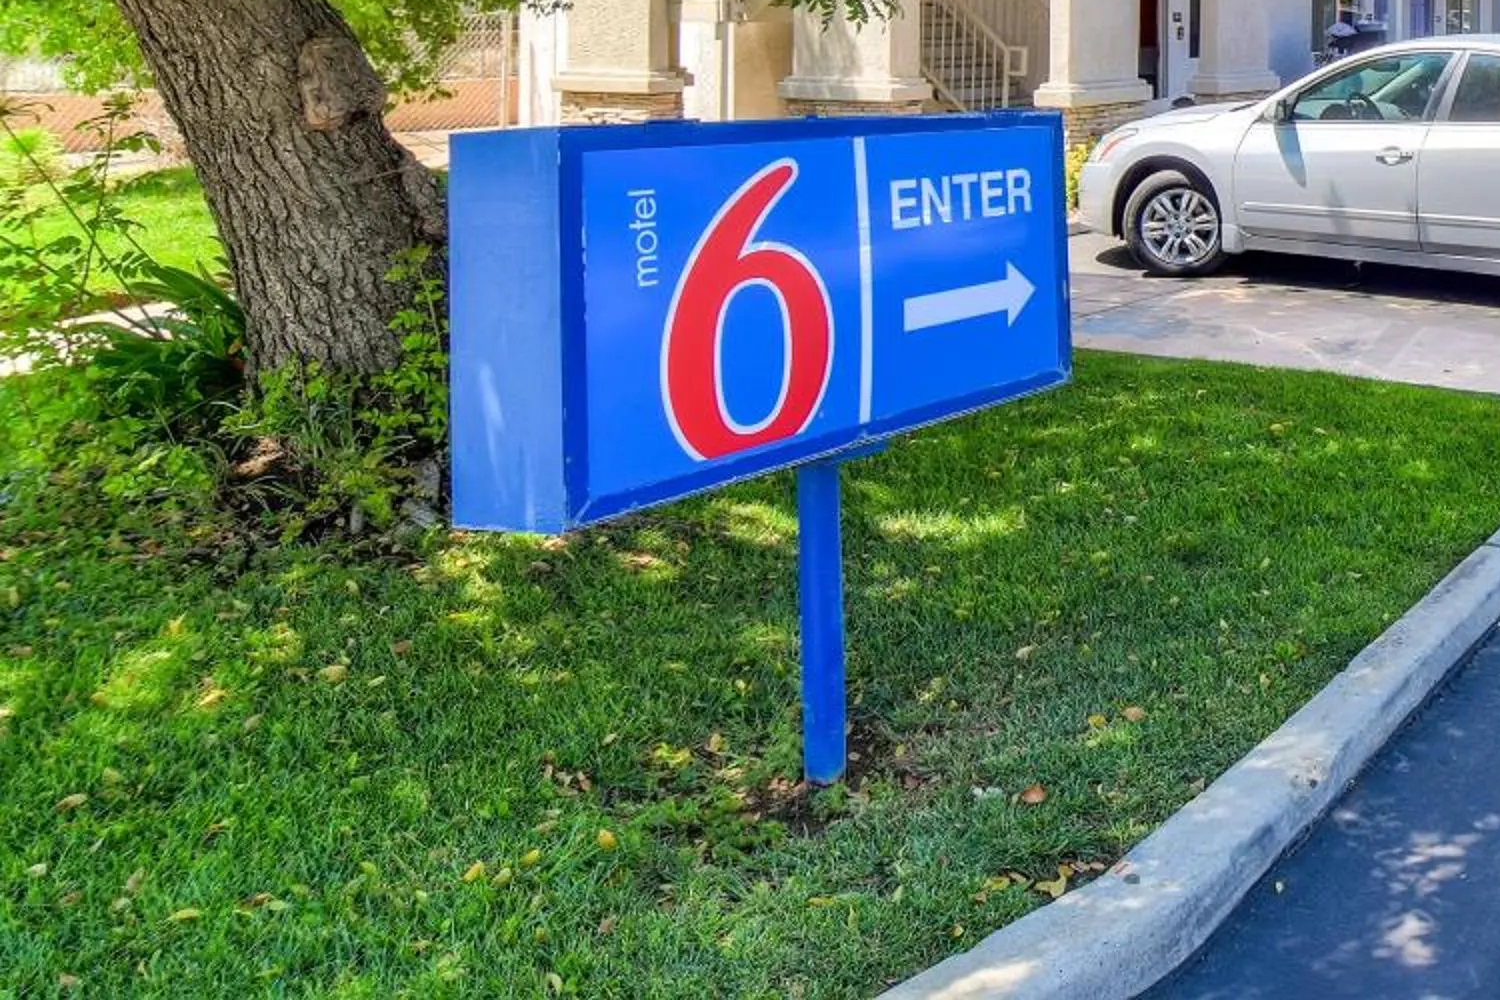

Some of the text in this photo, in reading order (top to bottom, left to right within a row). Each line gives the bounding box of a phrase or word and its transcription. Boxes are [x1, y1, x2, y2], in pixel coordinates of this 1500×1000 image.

[890, 168, 1033, 230] ENTER
[628, 157, 834, 460] motel 6
